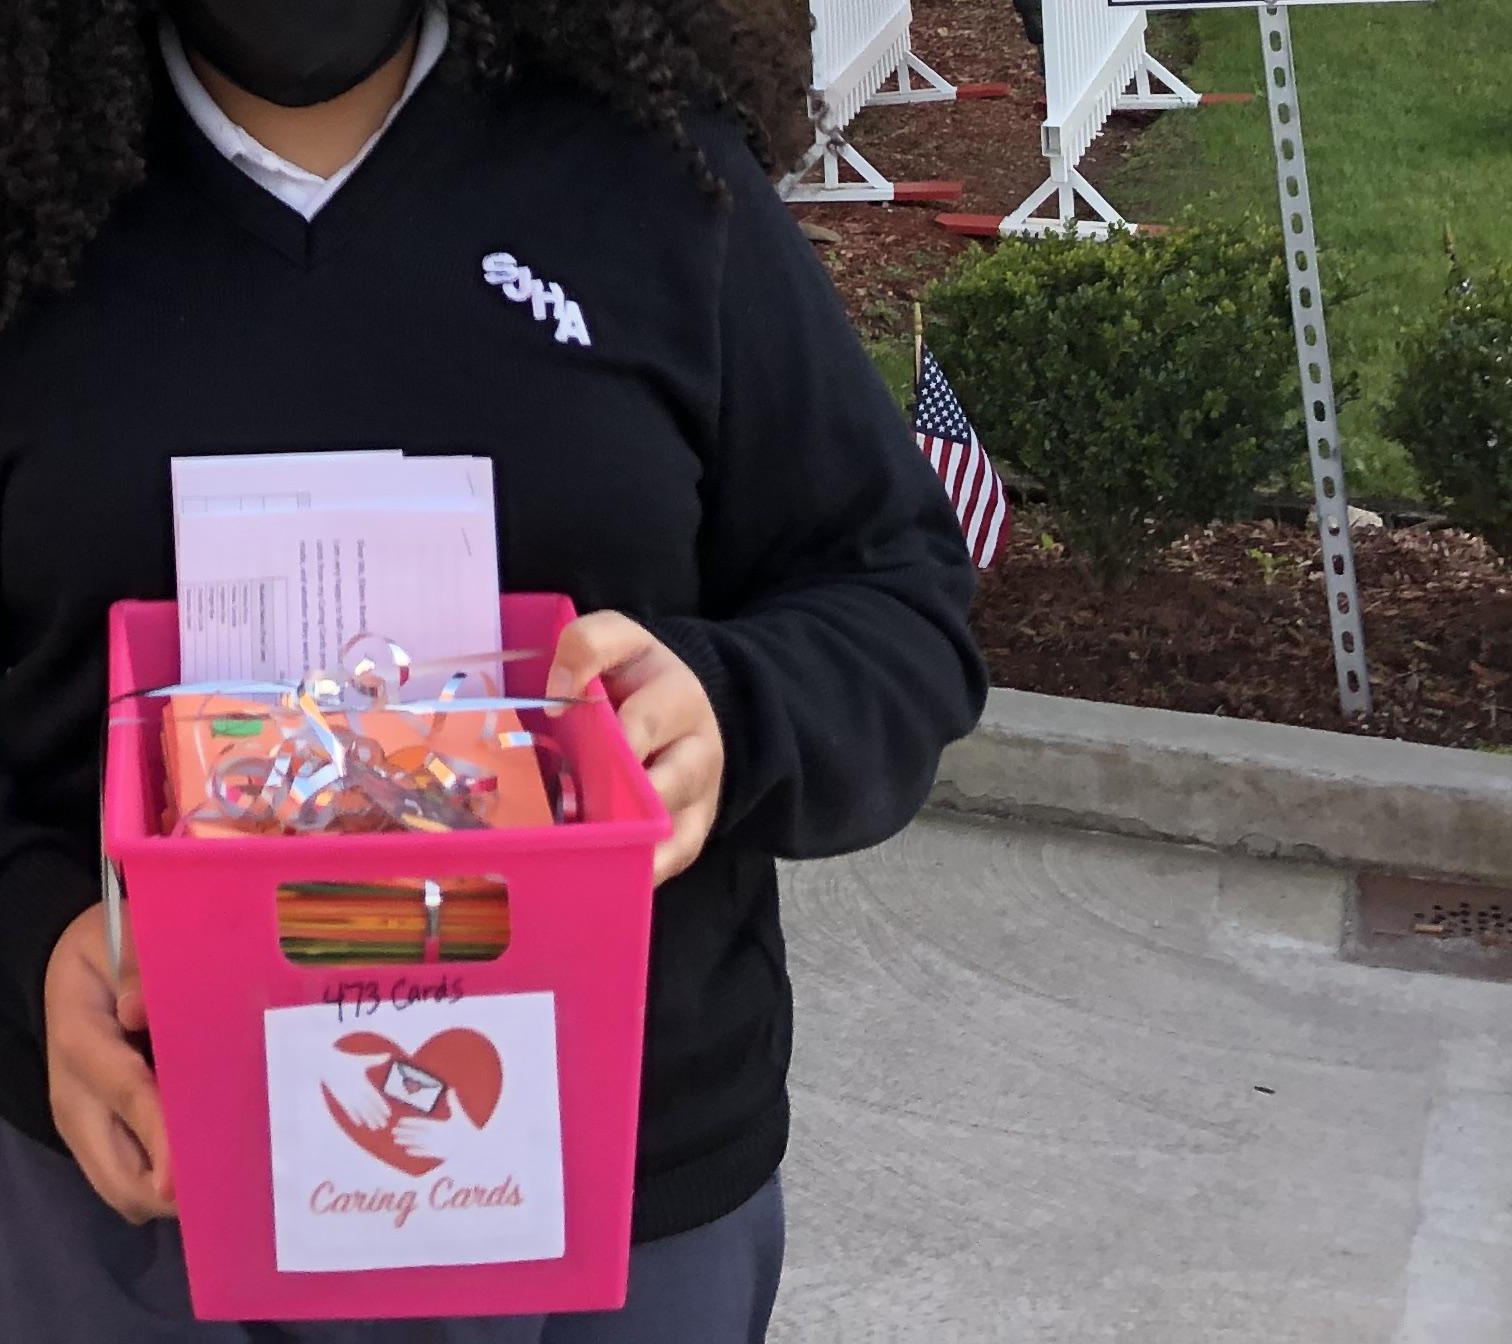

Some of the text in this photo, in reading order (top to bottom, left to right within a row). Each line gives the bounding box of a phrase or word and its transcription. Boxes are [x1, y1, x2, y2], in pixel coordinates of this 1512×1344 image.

[323, 976, 464, 1022] 473 Cards
[310, 1175, 524, 1229] Caring Cards
